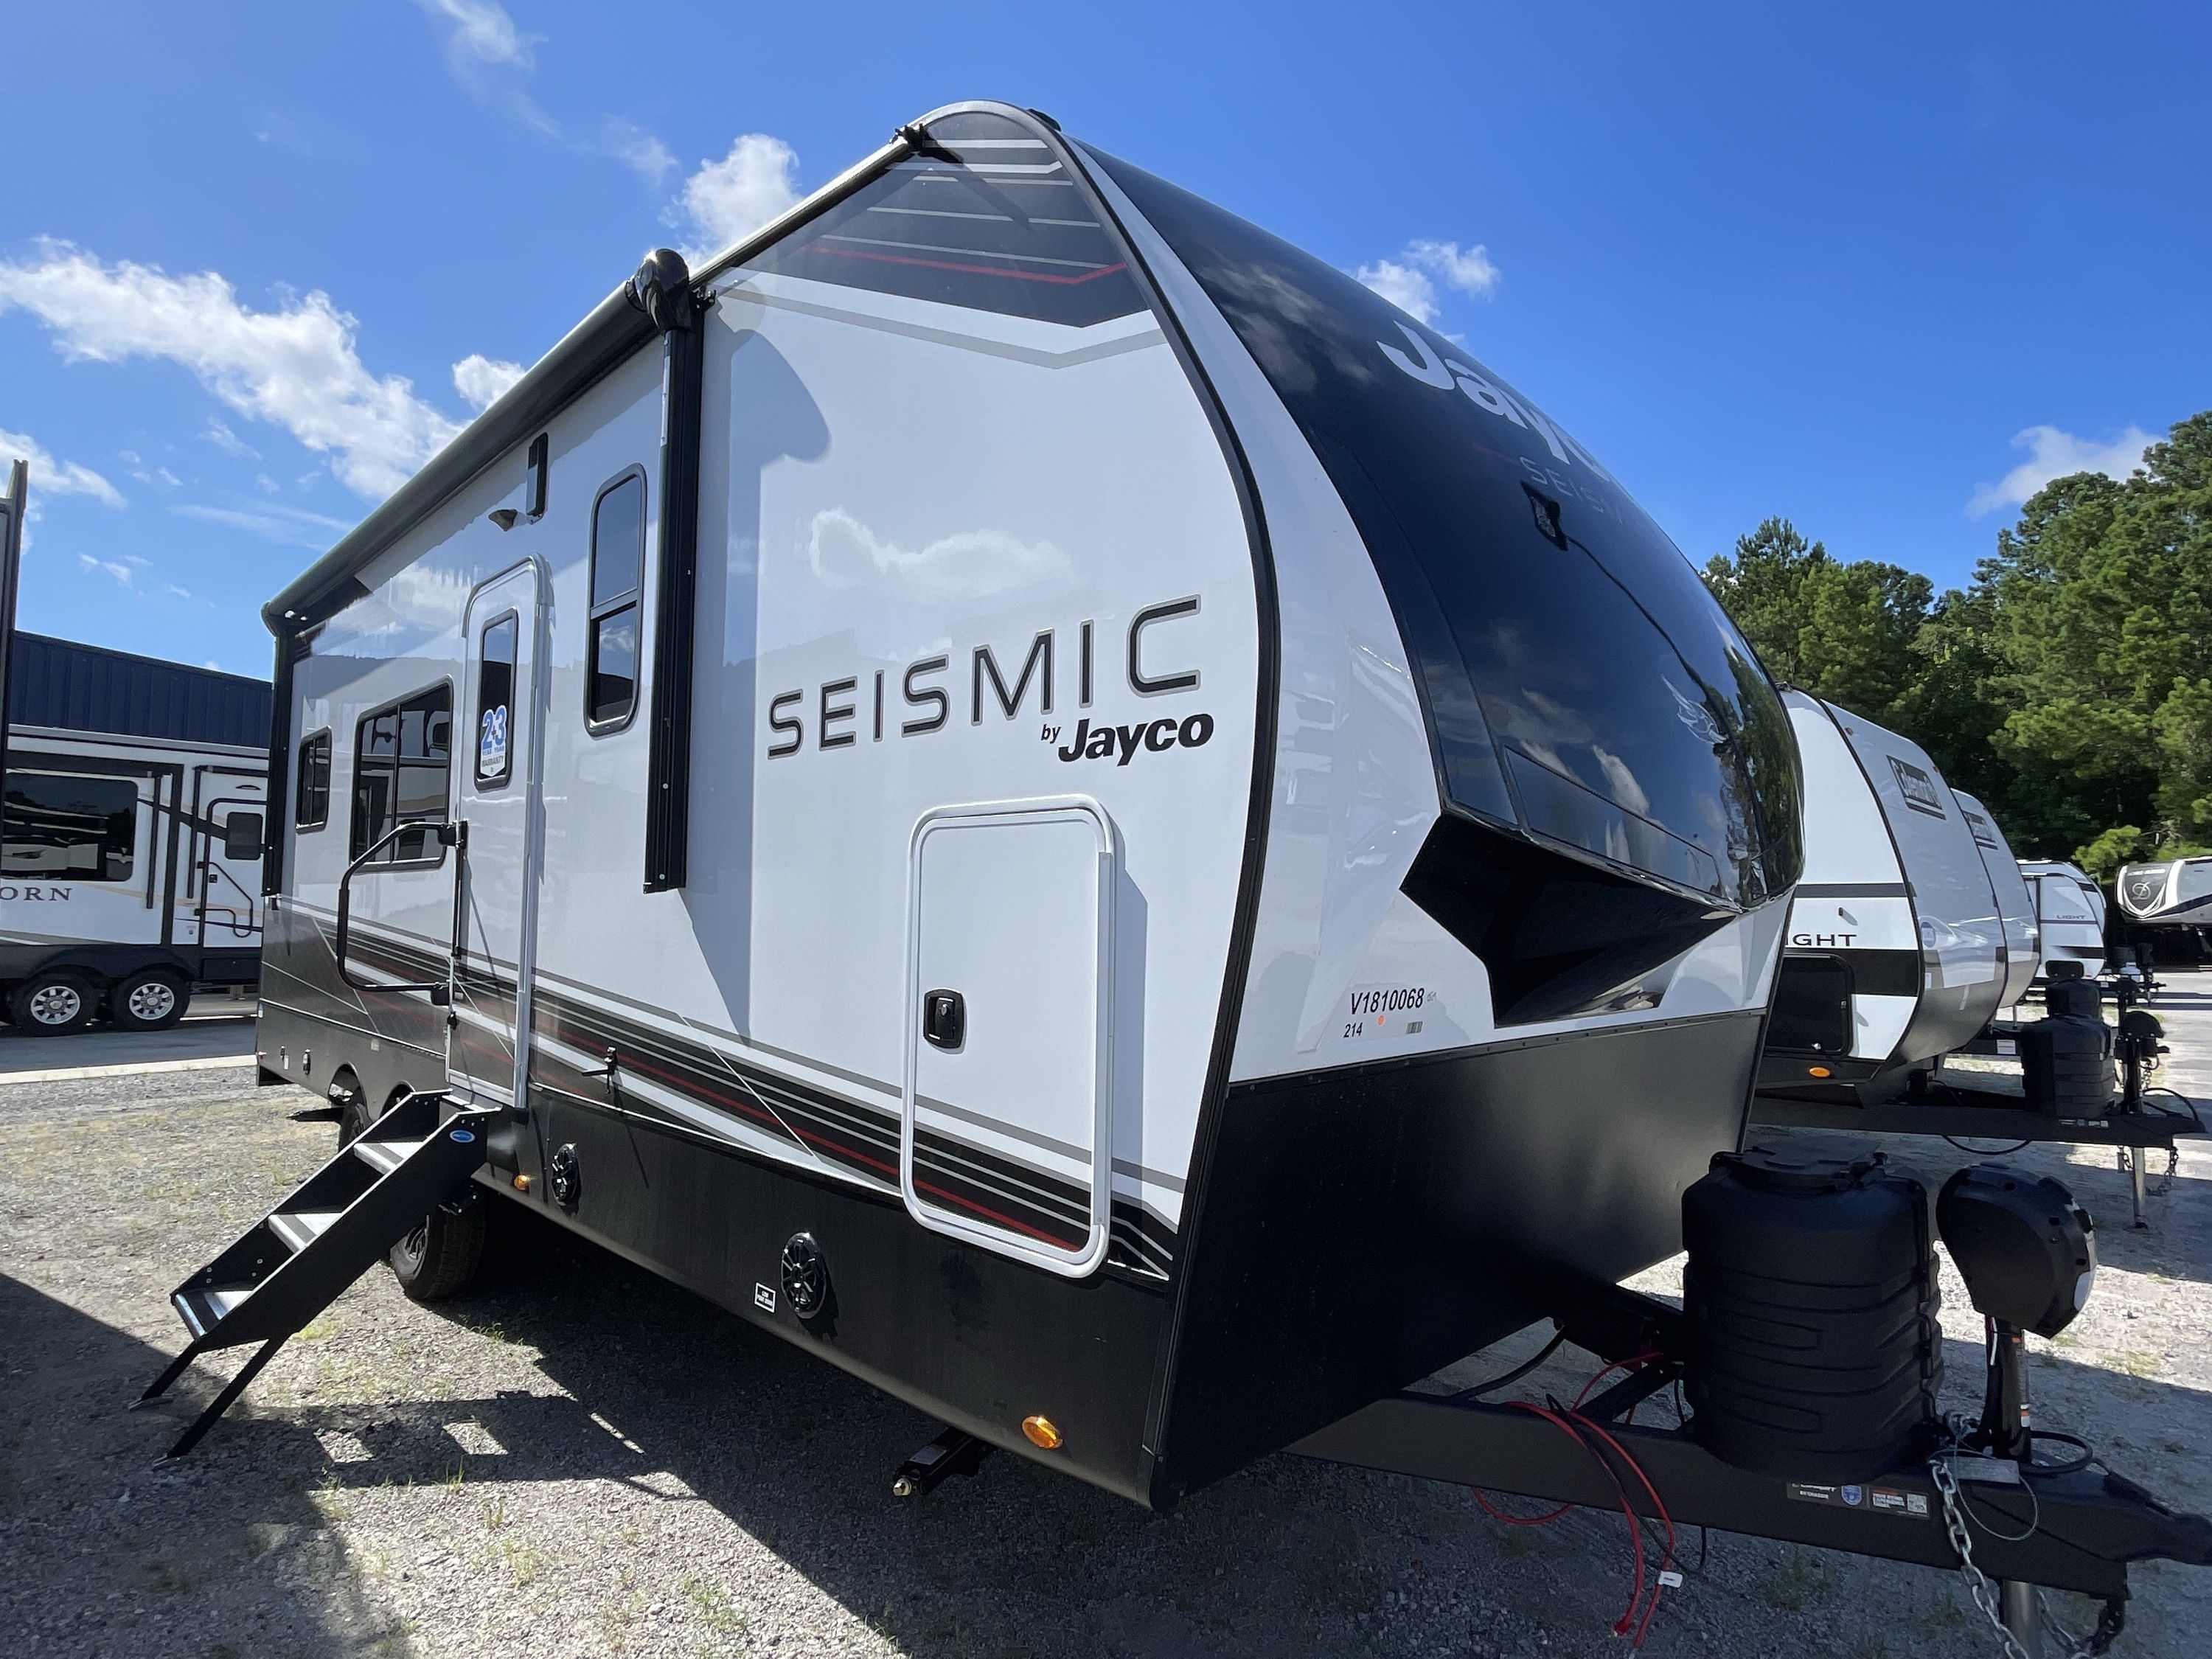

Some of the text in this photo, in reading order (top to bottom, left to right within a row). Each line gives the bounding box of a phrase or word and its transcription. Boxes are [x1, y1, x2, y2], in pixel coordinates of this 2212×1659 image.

[767, 594, 1201, 760] SEISMIC
[1040, 713, 1214, 766] by Jayco
[1352, 988, 1424, 1015] V1810068
[1343, 1022, 1363, 1037] 214
